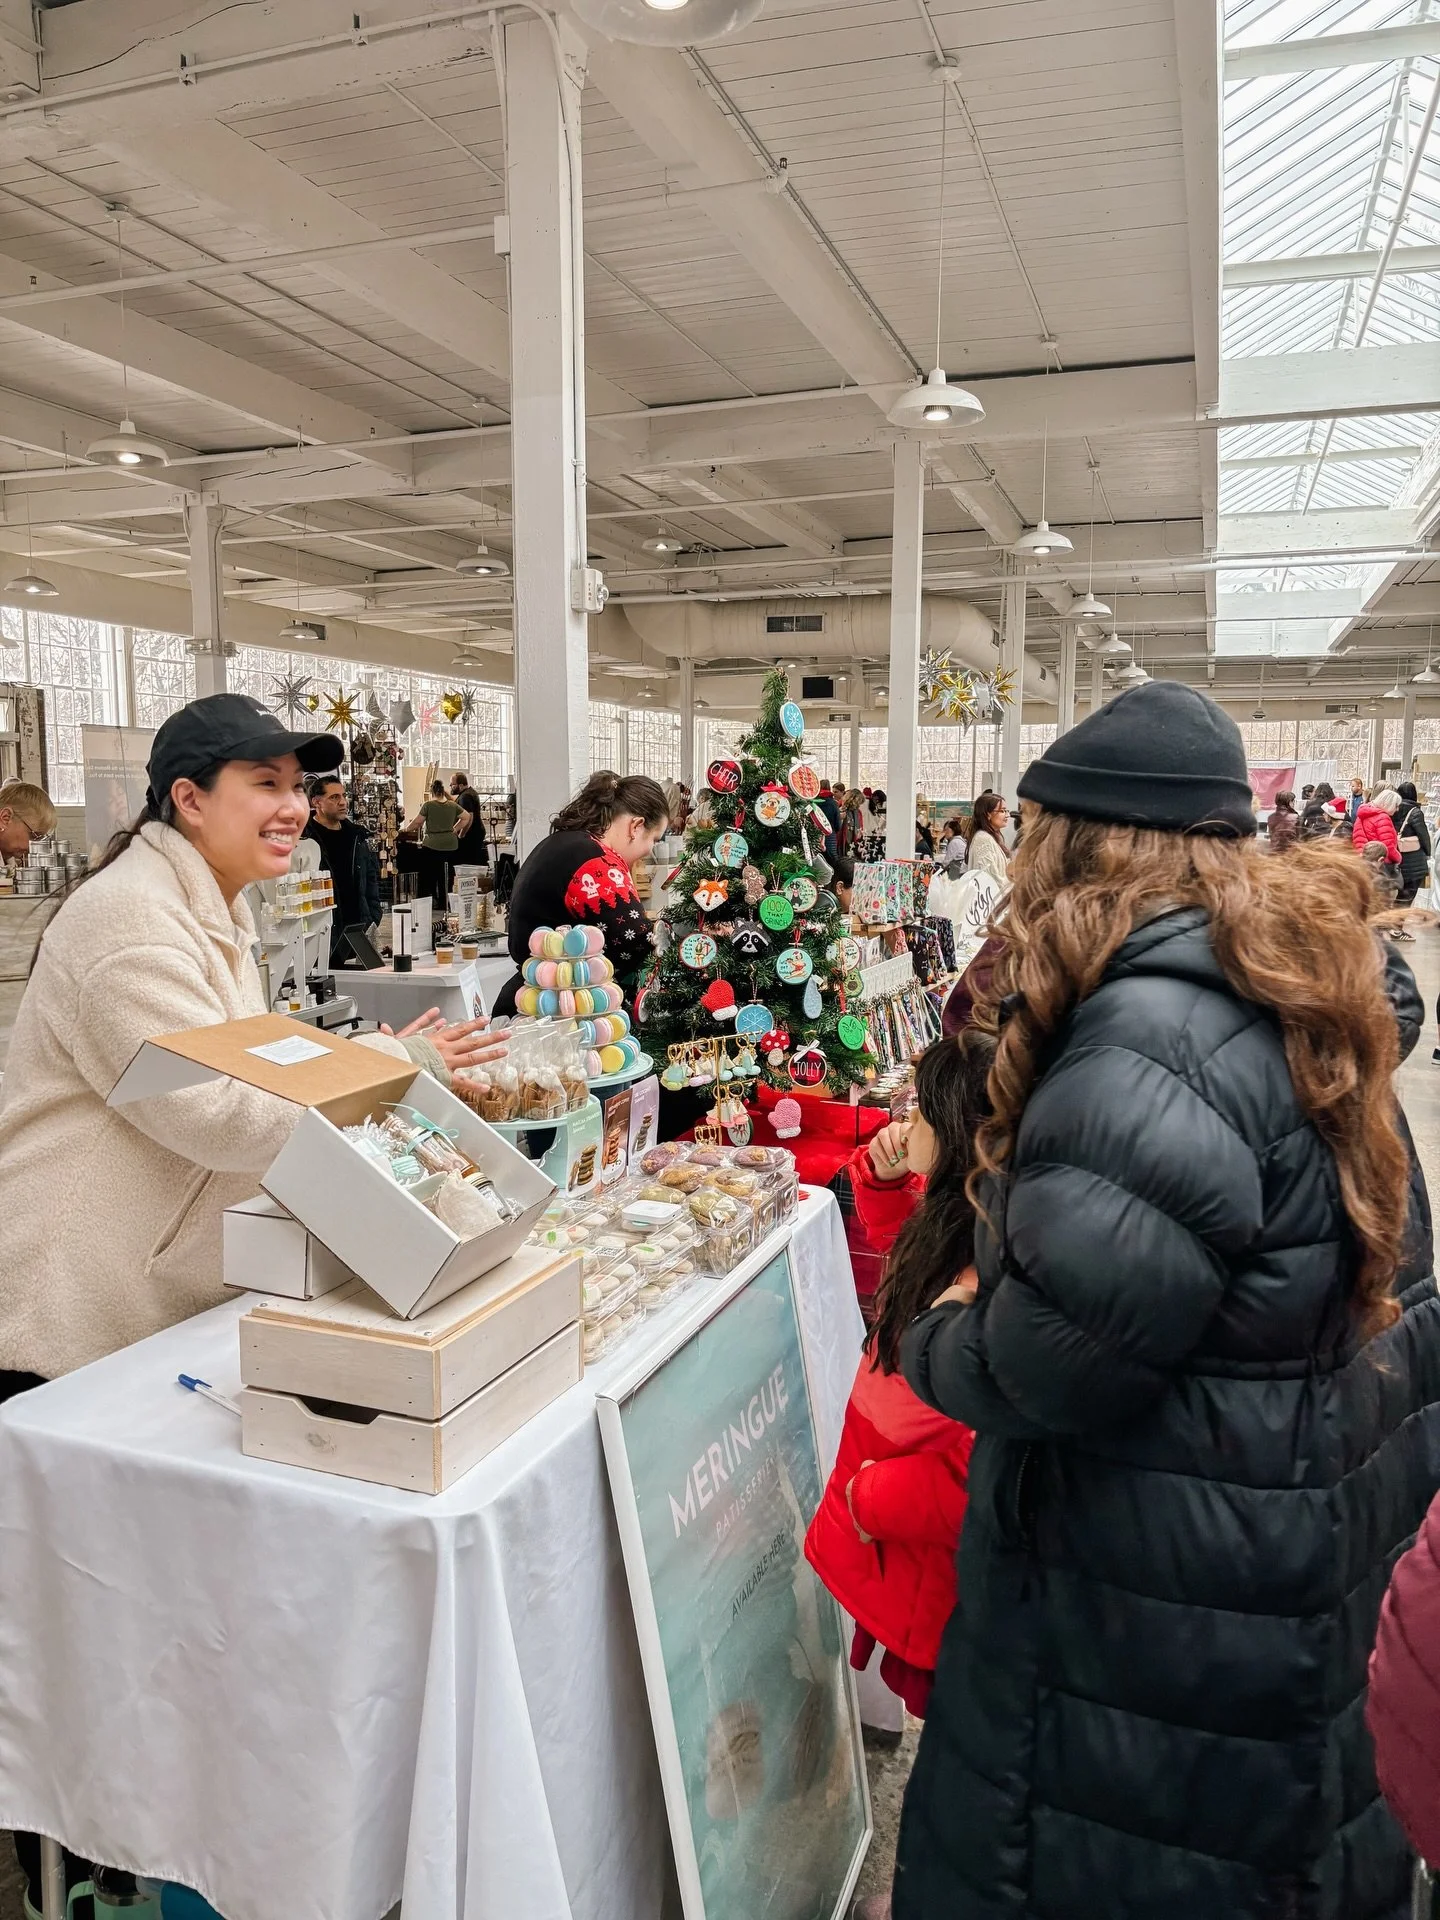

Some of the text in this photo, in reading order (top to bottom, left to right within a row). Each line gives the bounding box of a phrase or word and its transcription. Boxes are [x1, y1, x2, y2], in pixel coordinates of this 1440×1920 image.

[710, 763, 739, 789] CHEER
[795, 1061, 822, 1077] JOLLY
[668, 1363, 789, 1538] MERINGUE
[732, 1528, 786, 1621] AVAILABLE HERE
